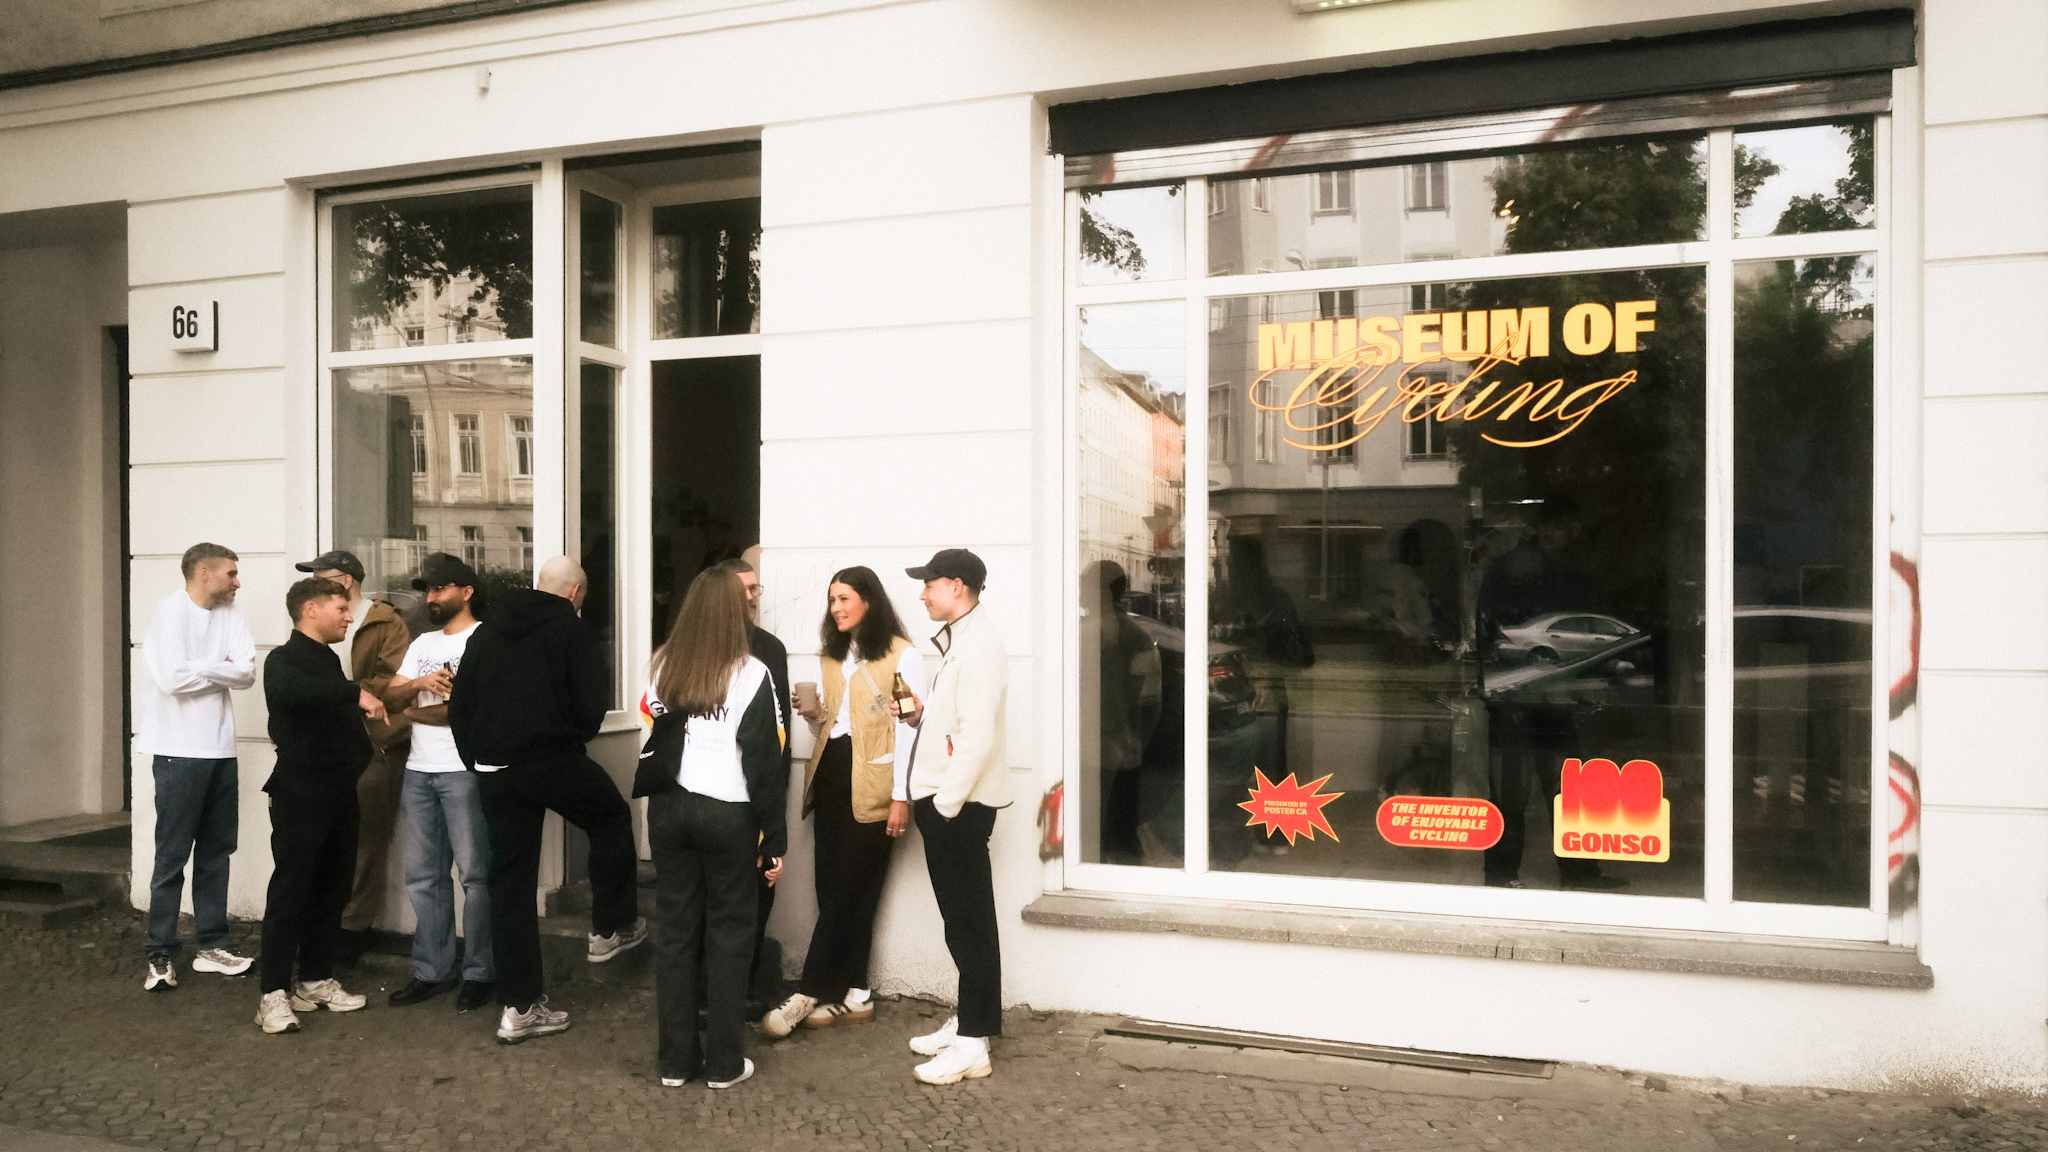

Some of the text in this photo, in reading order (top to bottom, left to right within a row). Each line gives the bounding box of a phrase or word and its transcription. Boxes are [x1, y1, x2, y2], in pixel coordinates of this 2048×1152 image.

[172, 305, 199, 339] 66
[1257, 300, 1657, 371] MUSEUM OF
[1249, 332, 1638, 450] Cycling
[1264, 807, 1308, 816] POSTER CA
[1391, 802, 1488, 817] THE INVENTOR
[1391, 815, 1488, 830] OF ENJOYABLE
[1409, 829, 1469, 843] CYCLING
[1561, 831, 1661, 856] GONSO
